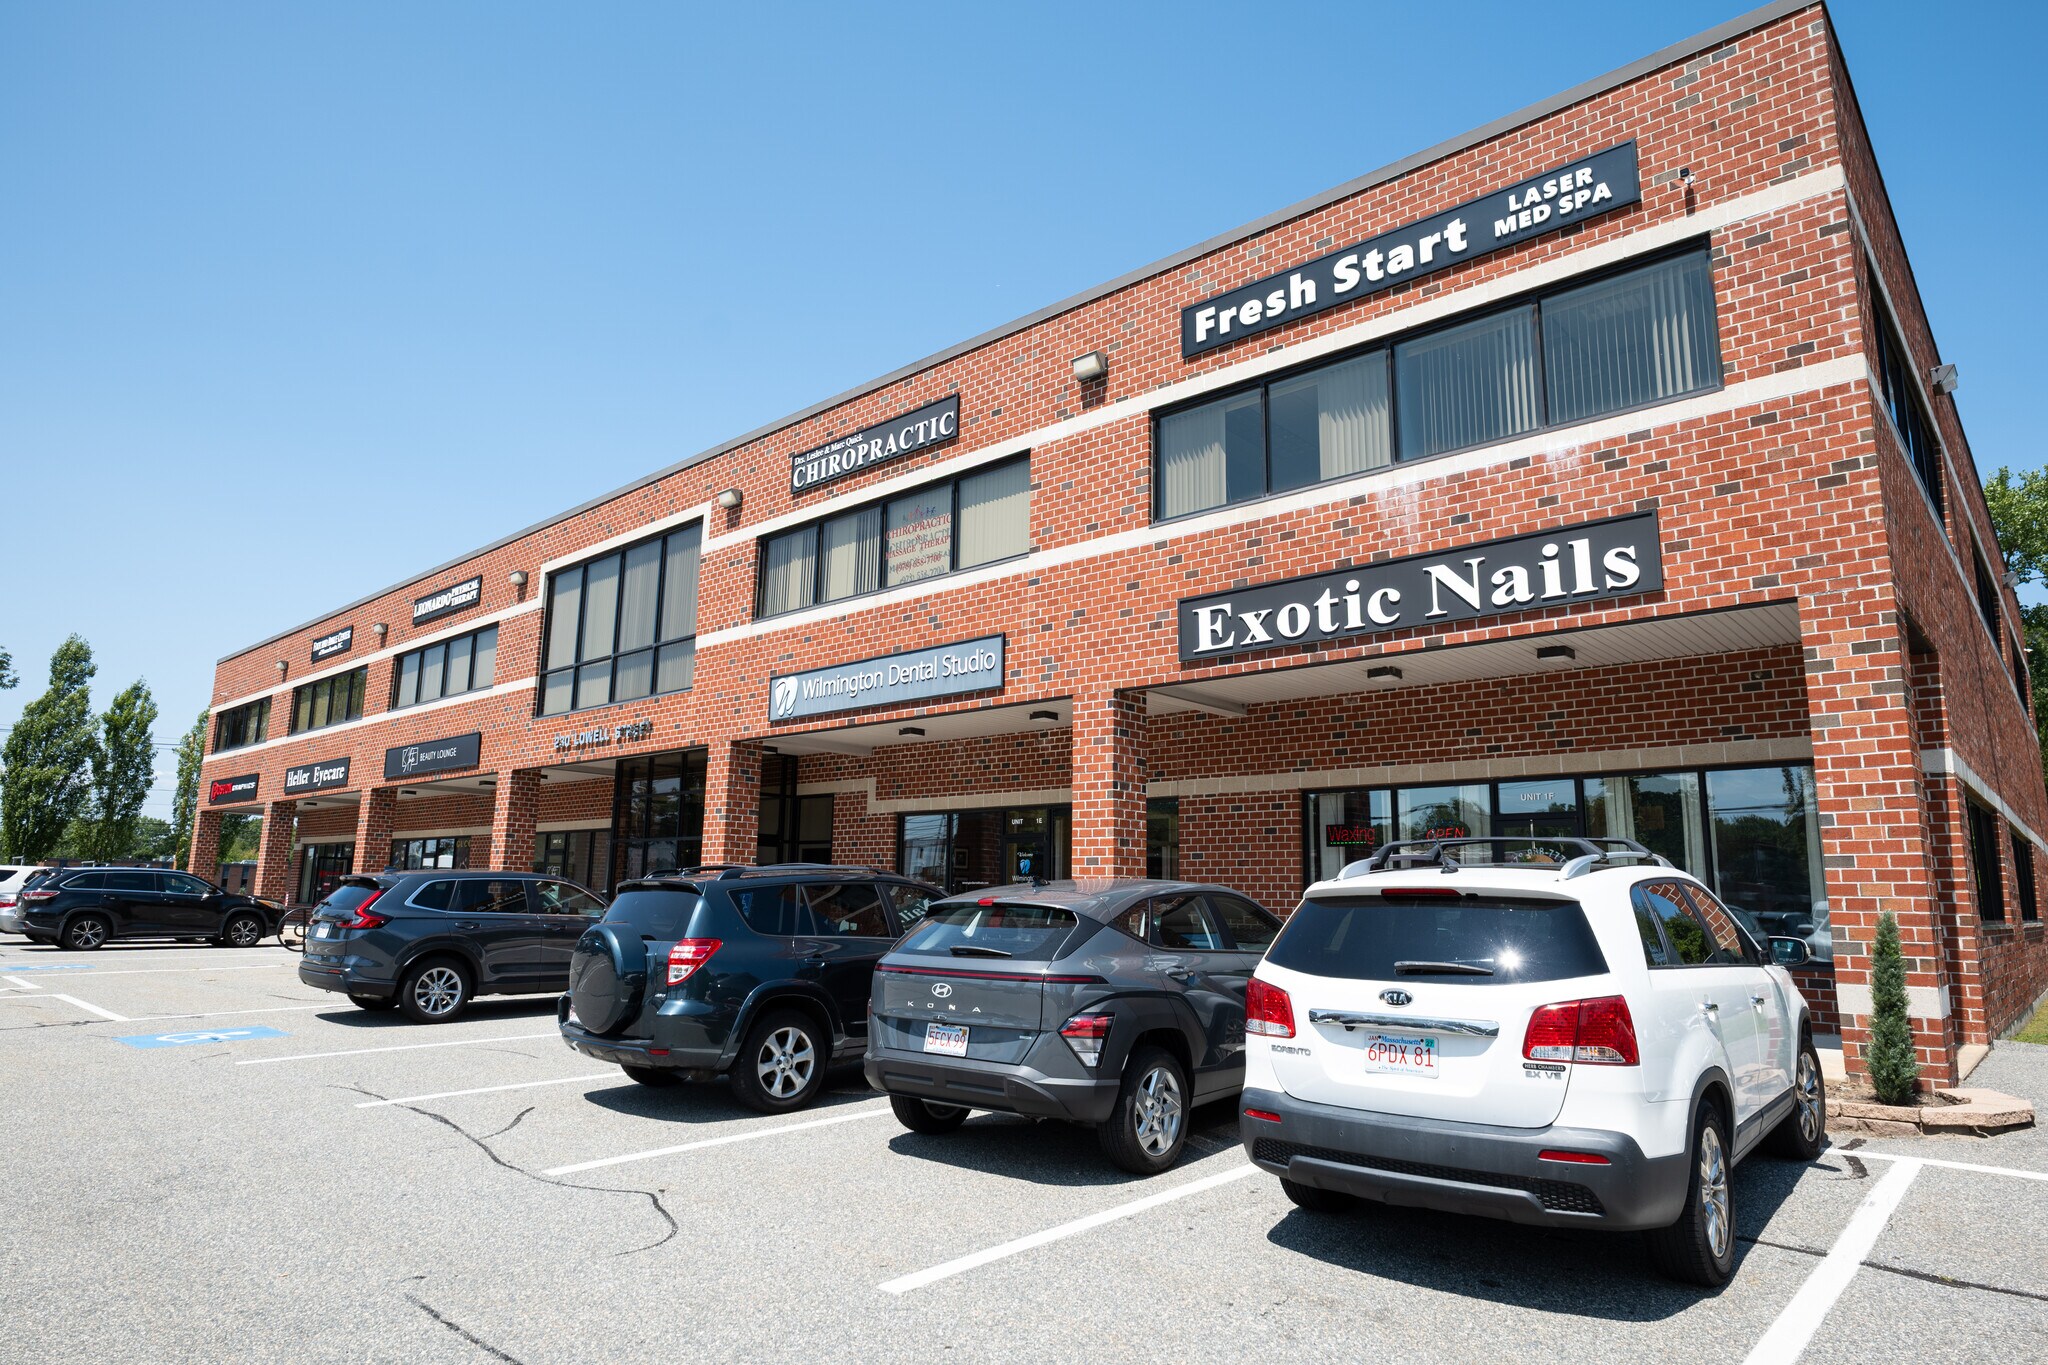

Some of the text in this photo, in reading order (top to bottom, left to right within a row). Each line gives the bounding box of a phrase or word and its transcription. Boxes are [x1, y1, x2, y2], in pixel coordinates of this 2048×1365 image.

[1508, 166, 1594, 212] LASER
[1494, 182, 1613, 238] MED SPA
[1195, 217, 1468, 343] Fresh Start
[793, 411, 955, 488] CHIROPRACTIC
[824, 446, 830, 455] &
[846, 433, 863, 447] Quick
[413, 593, 452, 618] LEONARDO
[451, 590, 478, 606] THERAPY
[1192, 538, 1641, 654] Exotic Nails
[803, 649, 996, 700] Wilmington Dental Studio
[554, 721, 653, 748] 230 LOWELL STREET
[420, 751, 436, 762] BEAUTY
[437, 747, 457, 759] LOUNGE
[286, 766, 345, 787] Heller Eyecare
[1520, 792, 1554, 801] UNIT 1F
[1327, 825, 1376, 844] Waxing
[1426, 827, 1465, 840] OPEN
[907, 1001, 981, 1013] KONA
[1384, 992, 1407, 1004] KIA
[928, 1030, 966, 1049] 5FCX 99
[1271, 1044, 1311, 1056] SORENTO
[1380, 1036, 1421, 1046] Massachusetts
[1368, 1042, 1434, 1068] 6PDX 81
